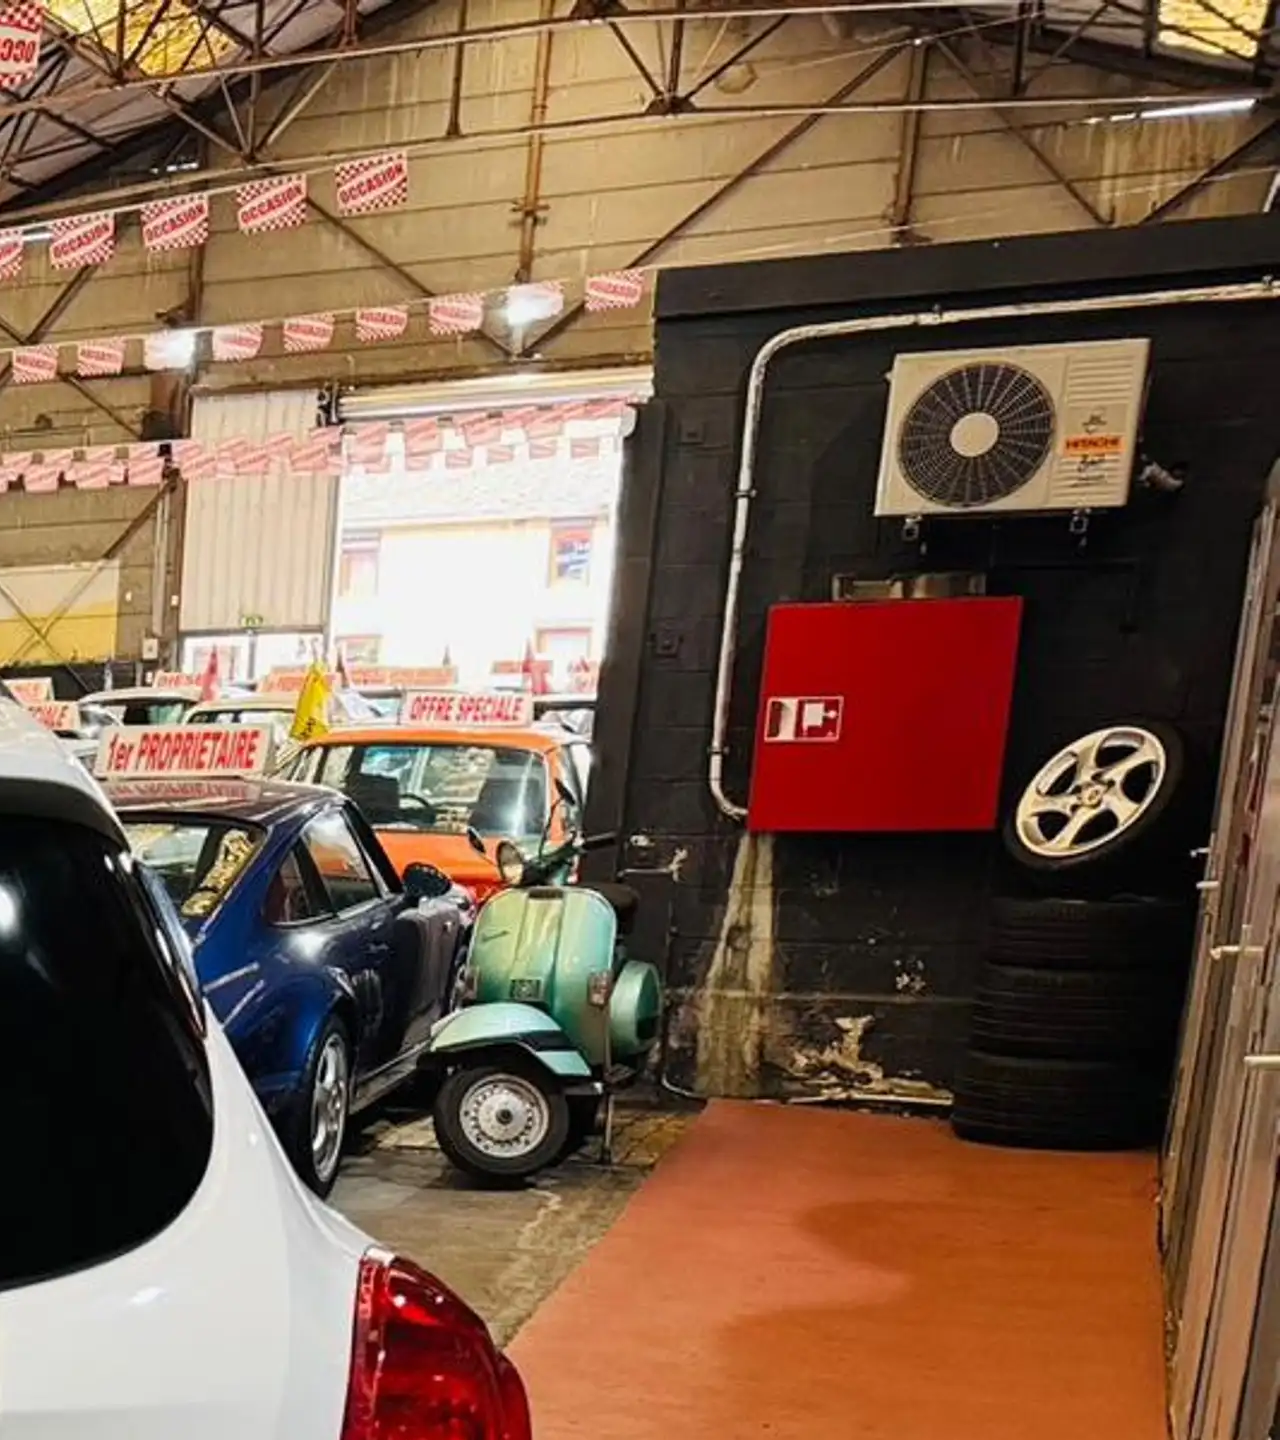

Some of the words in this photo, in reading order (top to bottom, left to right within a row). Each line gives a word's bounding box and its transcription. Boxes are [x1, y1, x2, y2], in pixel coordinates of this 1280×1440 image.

[340, 162, 403, 202] OCCASION
[144, 203, 205, 239] OCCASION
[241, 184, 301, 224] OCCASION
[53, 221, 110, 257] OCCASION
[409, 696, 454, 721] OFFRE
[106, 733, 134, 771] 1er
[135, 729, 262, 771] PROPRIETAIRE
